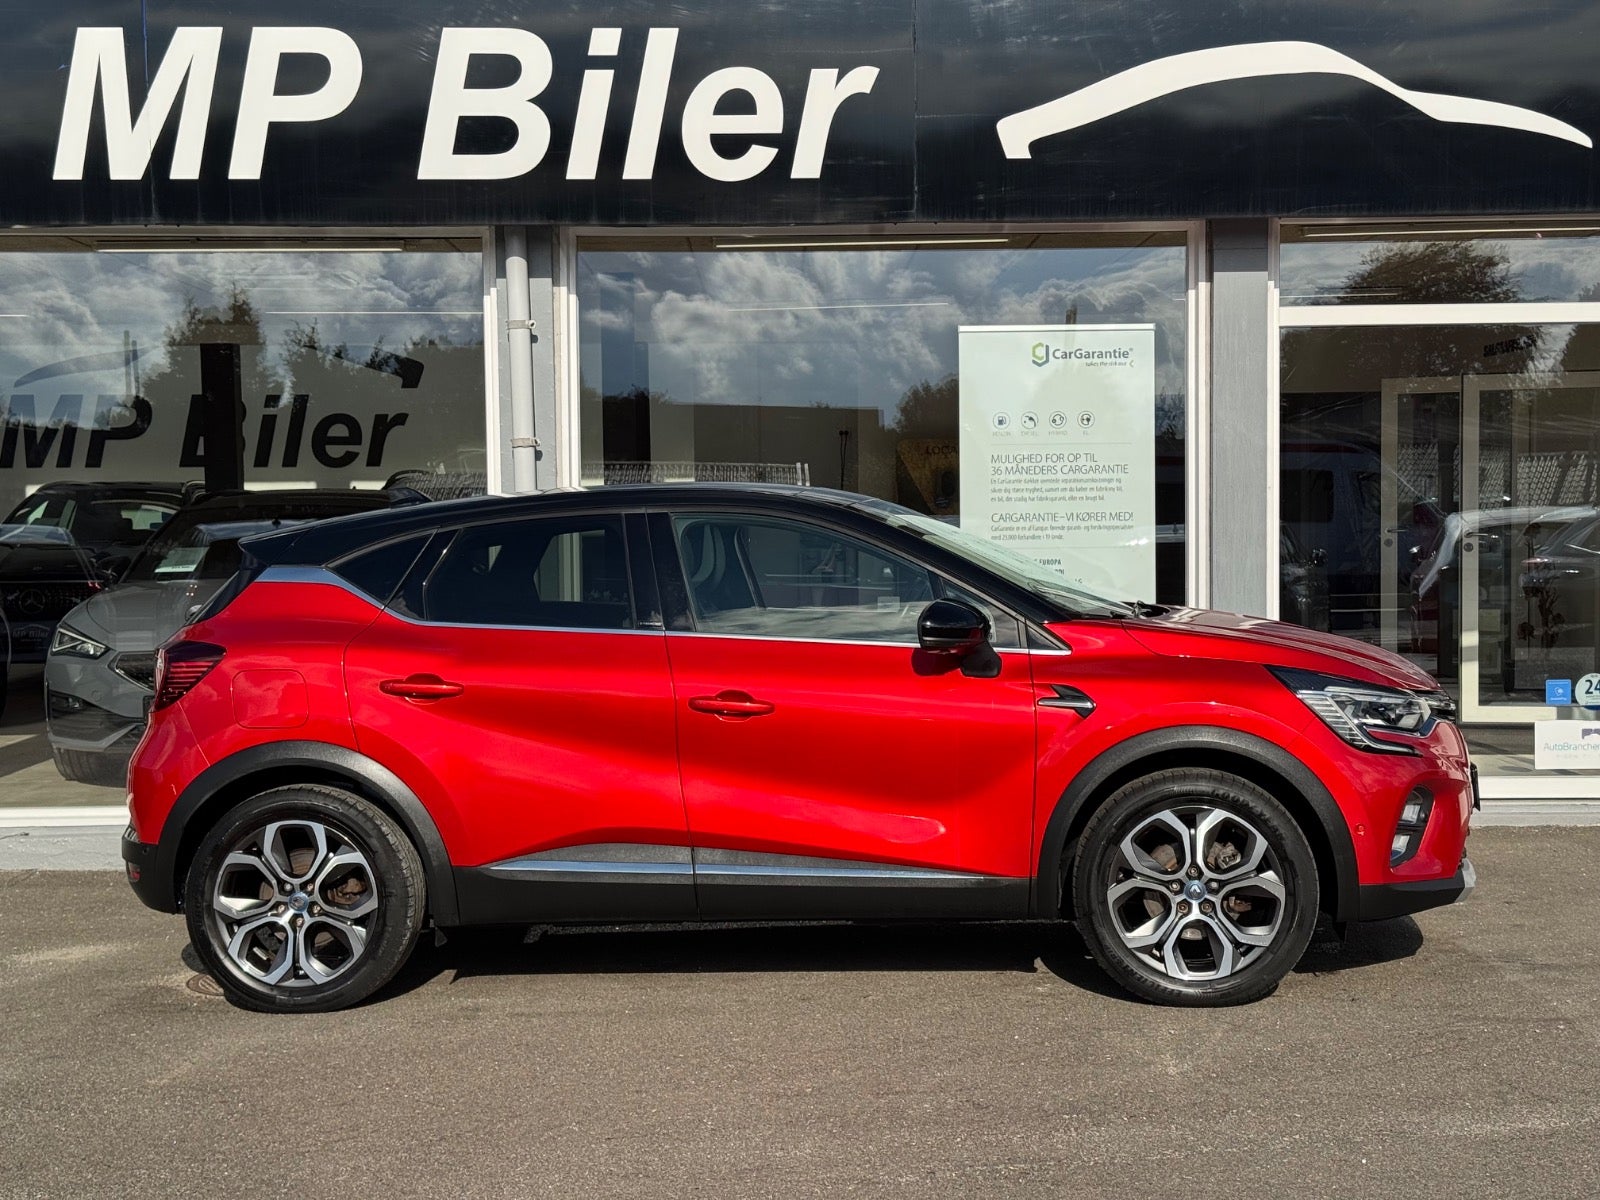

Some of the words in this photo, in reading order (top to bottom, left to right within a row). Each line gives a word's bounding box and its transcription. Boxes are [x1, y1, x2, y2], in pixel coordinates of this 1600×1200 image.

[52, 26, 364, 181] MP
[416, 26, 881, 182] Biler
[1052, 347, 1130, 360] CarGarantie
[0, 394, 153, 469] MP
[991, 453, 1043, 464] MULIGHED
[1045, 453, 1065, 463] FOR
[1067, 453, 1082, 463] OP
[1083, 453, 1098, 463] TIL
[991, 466, 1003, 476] 36
[1004, 464, 1058, 476] MÅNEDERS
[1060, 464, 1129, 475] CARGARANTIE
[1076, 512, 1107, 522] KØRER
[1108, 511, 1134, 522] MED!
[1543, 742, 1600, 751] AutoBranche
